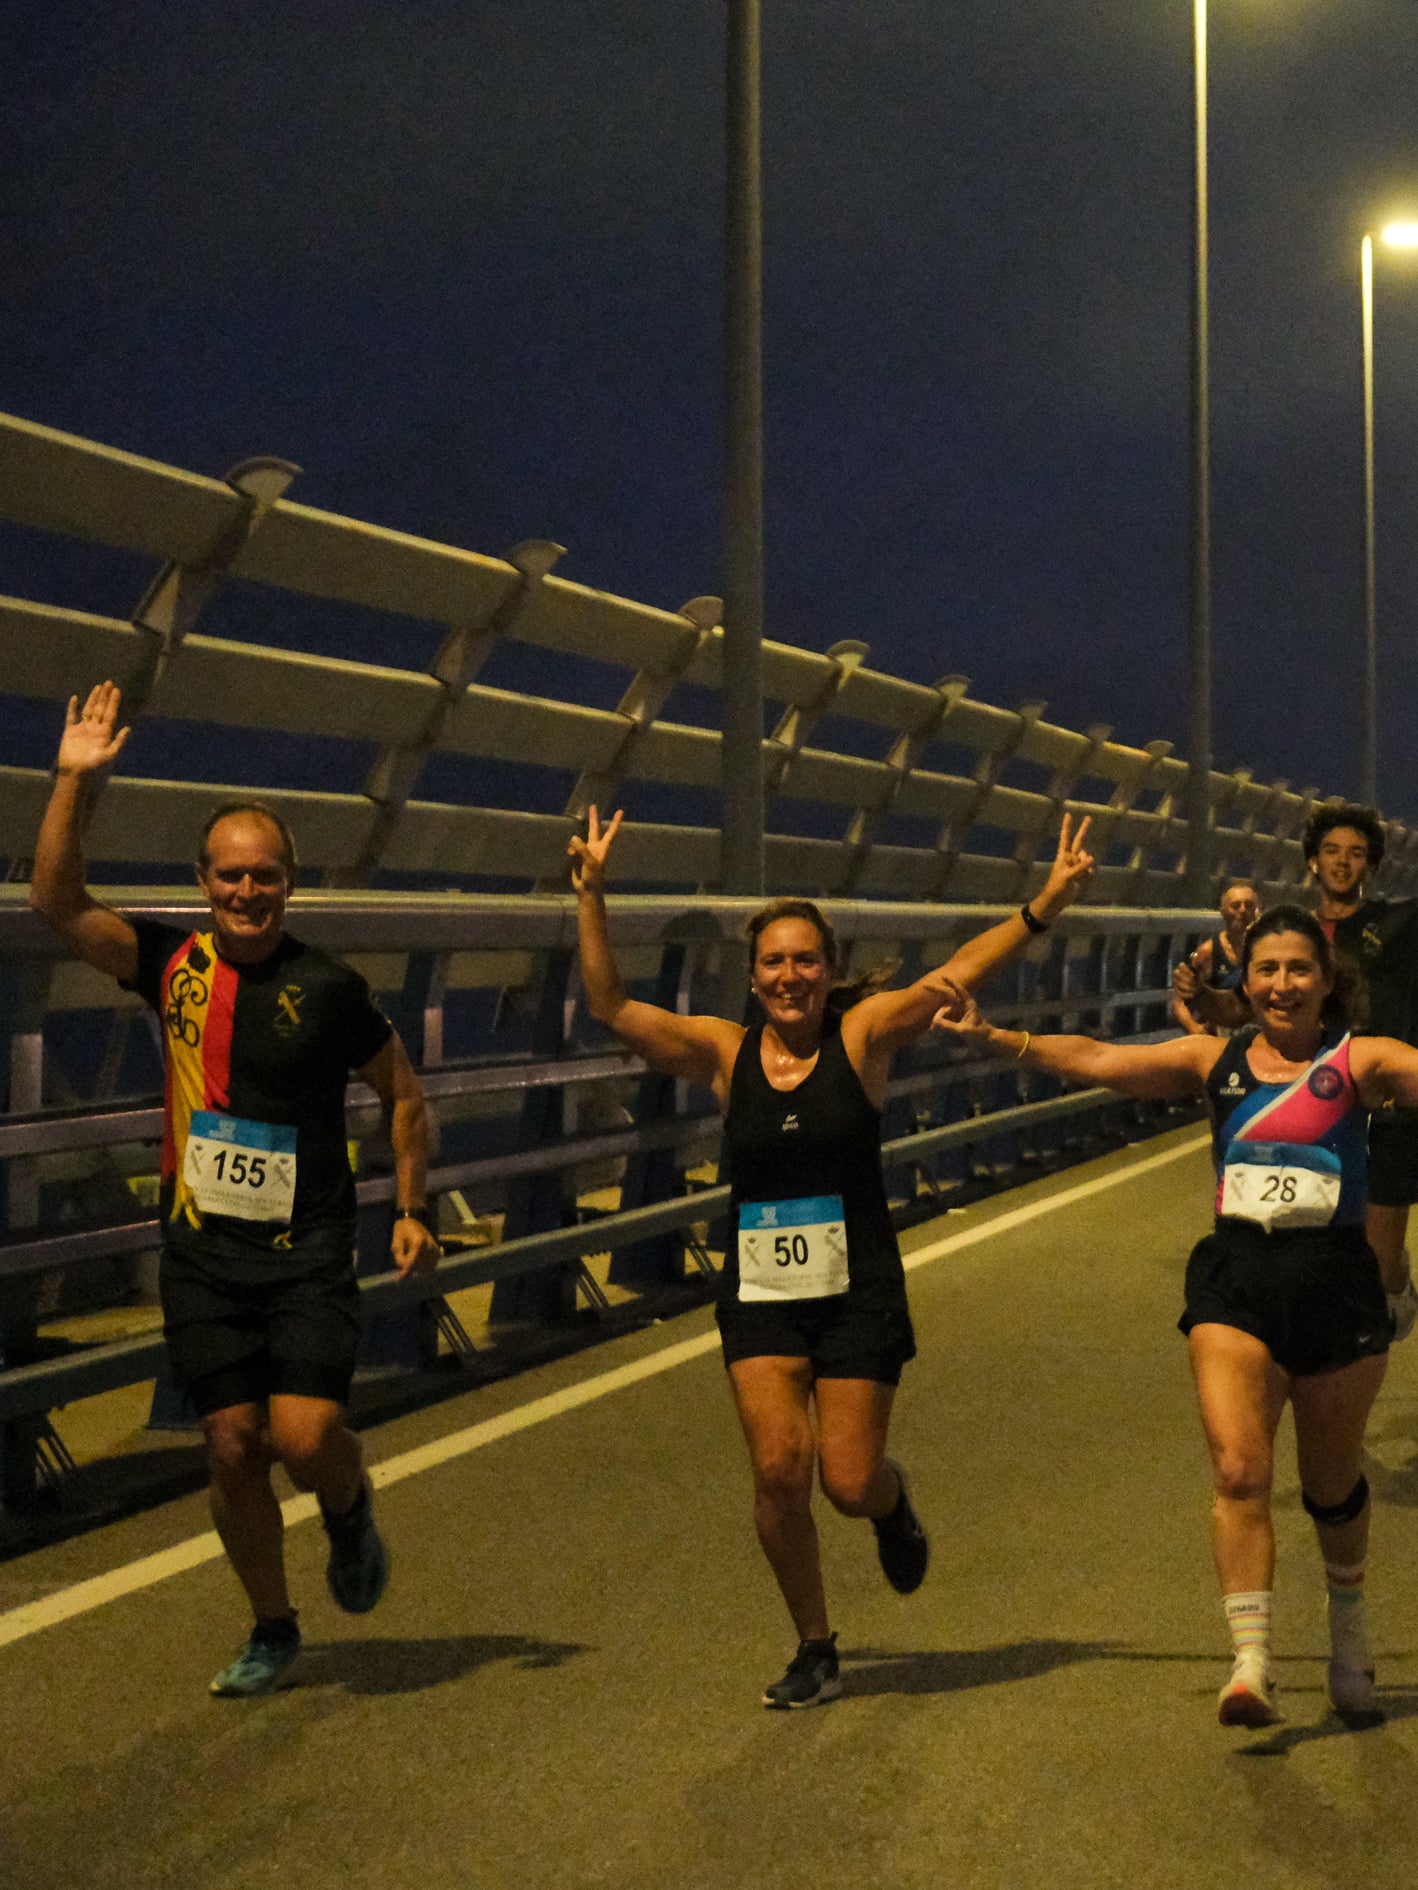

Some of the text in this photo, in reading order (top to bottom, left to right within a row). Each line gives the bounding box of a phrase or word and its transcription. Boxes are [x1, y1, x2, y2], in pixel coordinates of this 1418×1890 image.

[213, 1150, 267, 1188] 155
[1259, 1175, 1298, 1203] 28
[774, 1234, 809, 1268] 50
